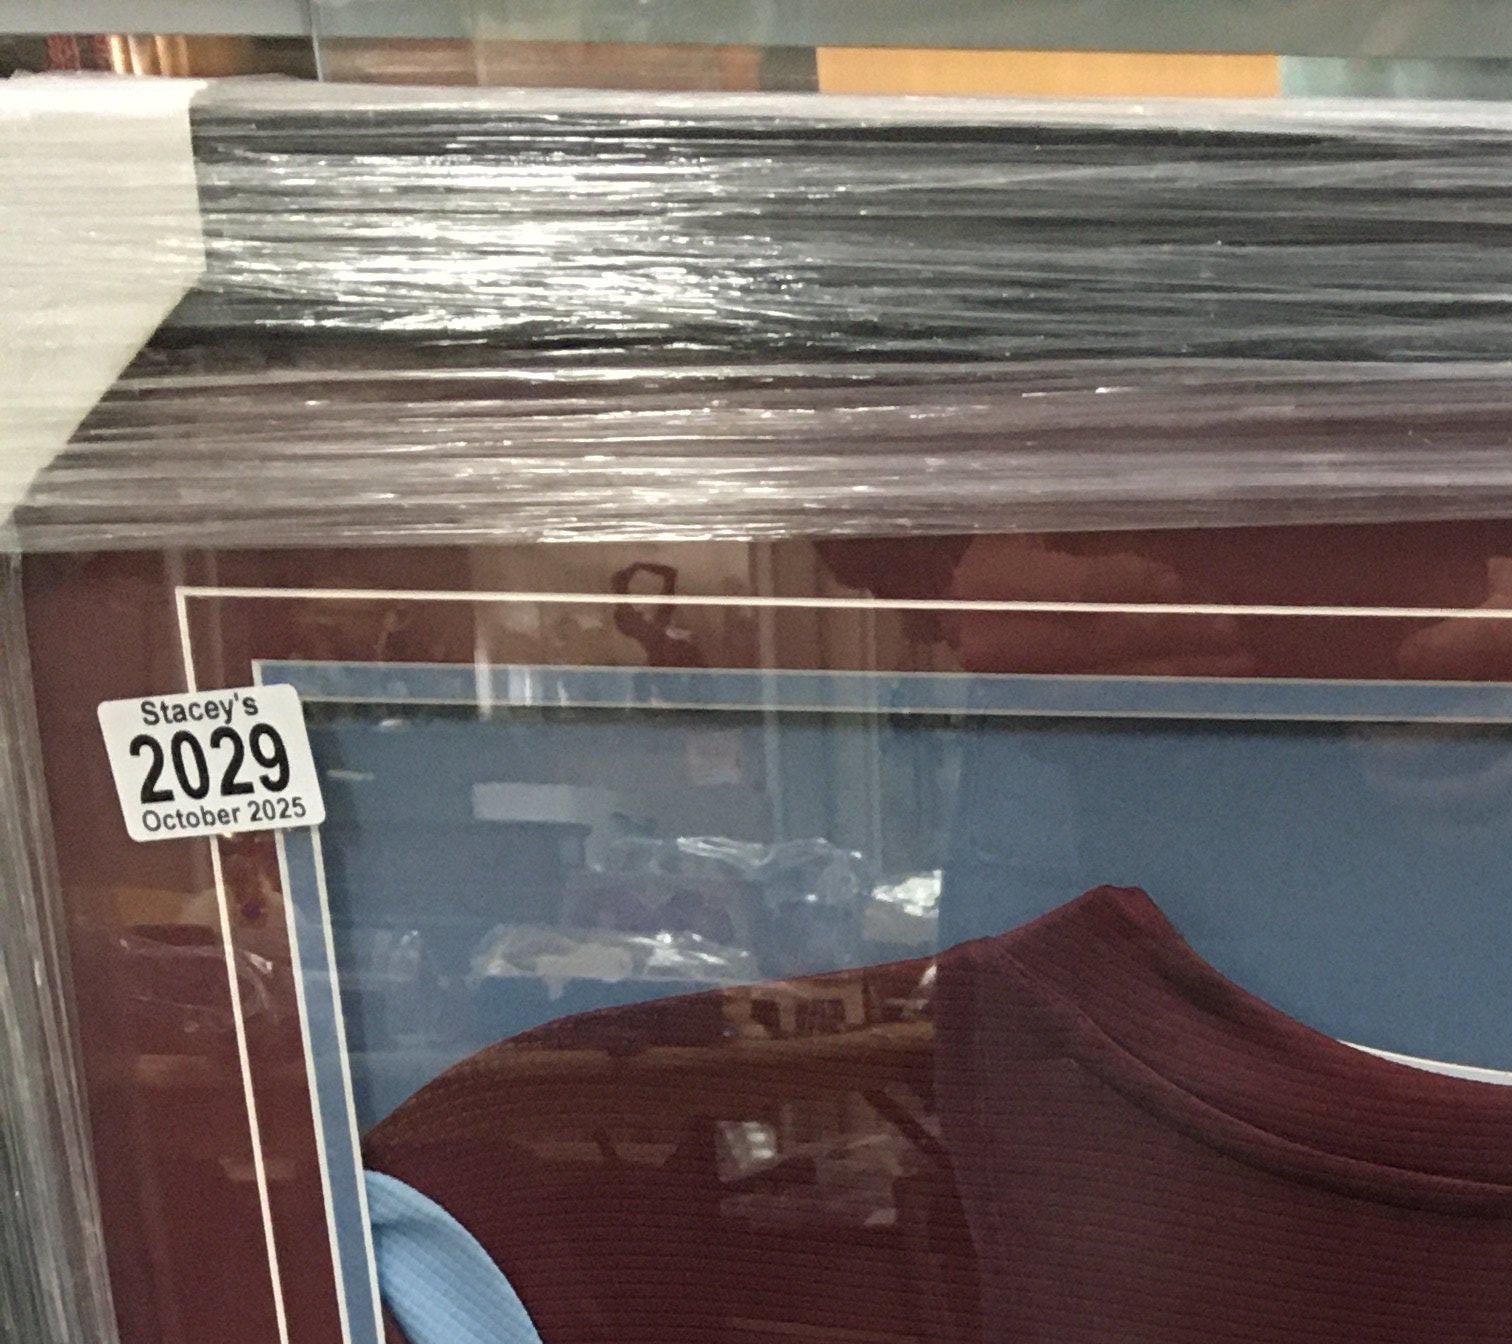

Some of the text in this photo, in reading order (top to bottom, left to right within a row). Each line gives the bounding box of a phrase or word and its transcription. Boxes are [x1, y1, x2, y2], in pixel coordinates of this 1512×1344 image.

[140, 692, 259, 725] Stacey's
[129, 722, 290, 804] 2029
[142, 797, 306, 832] October 2025
